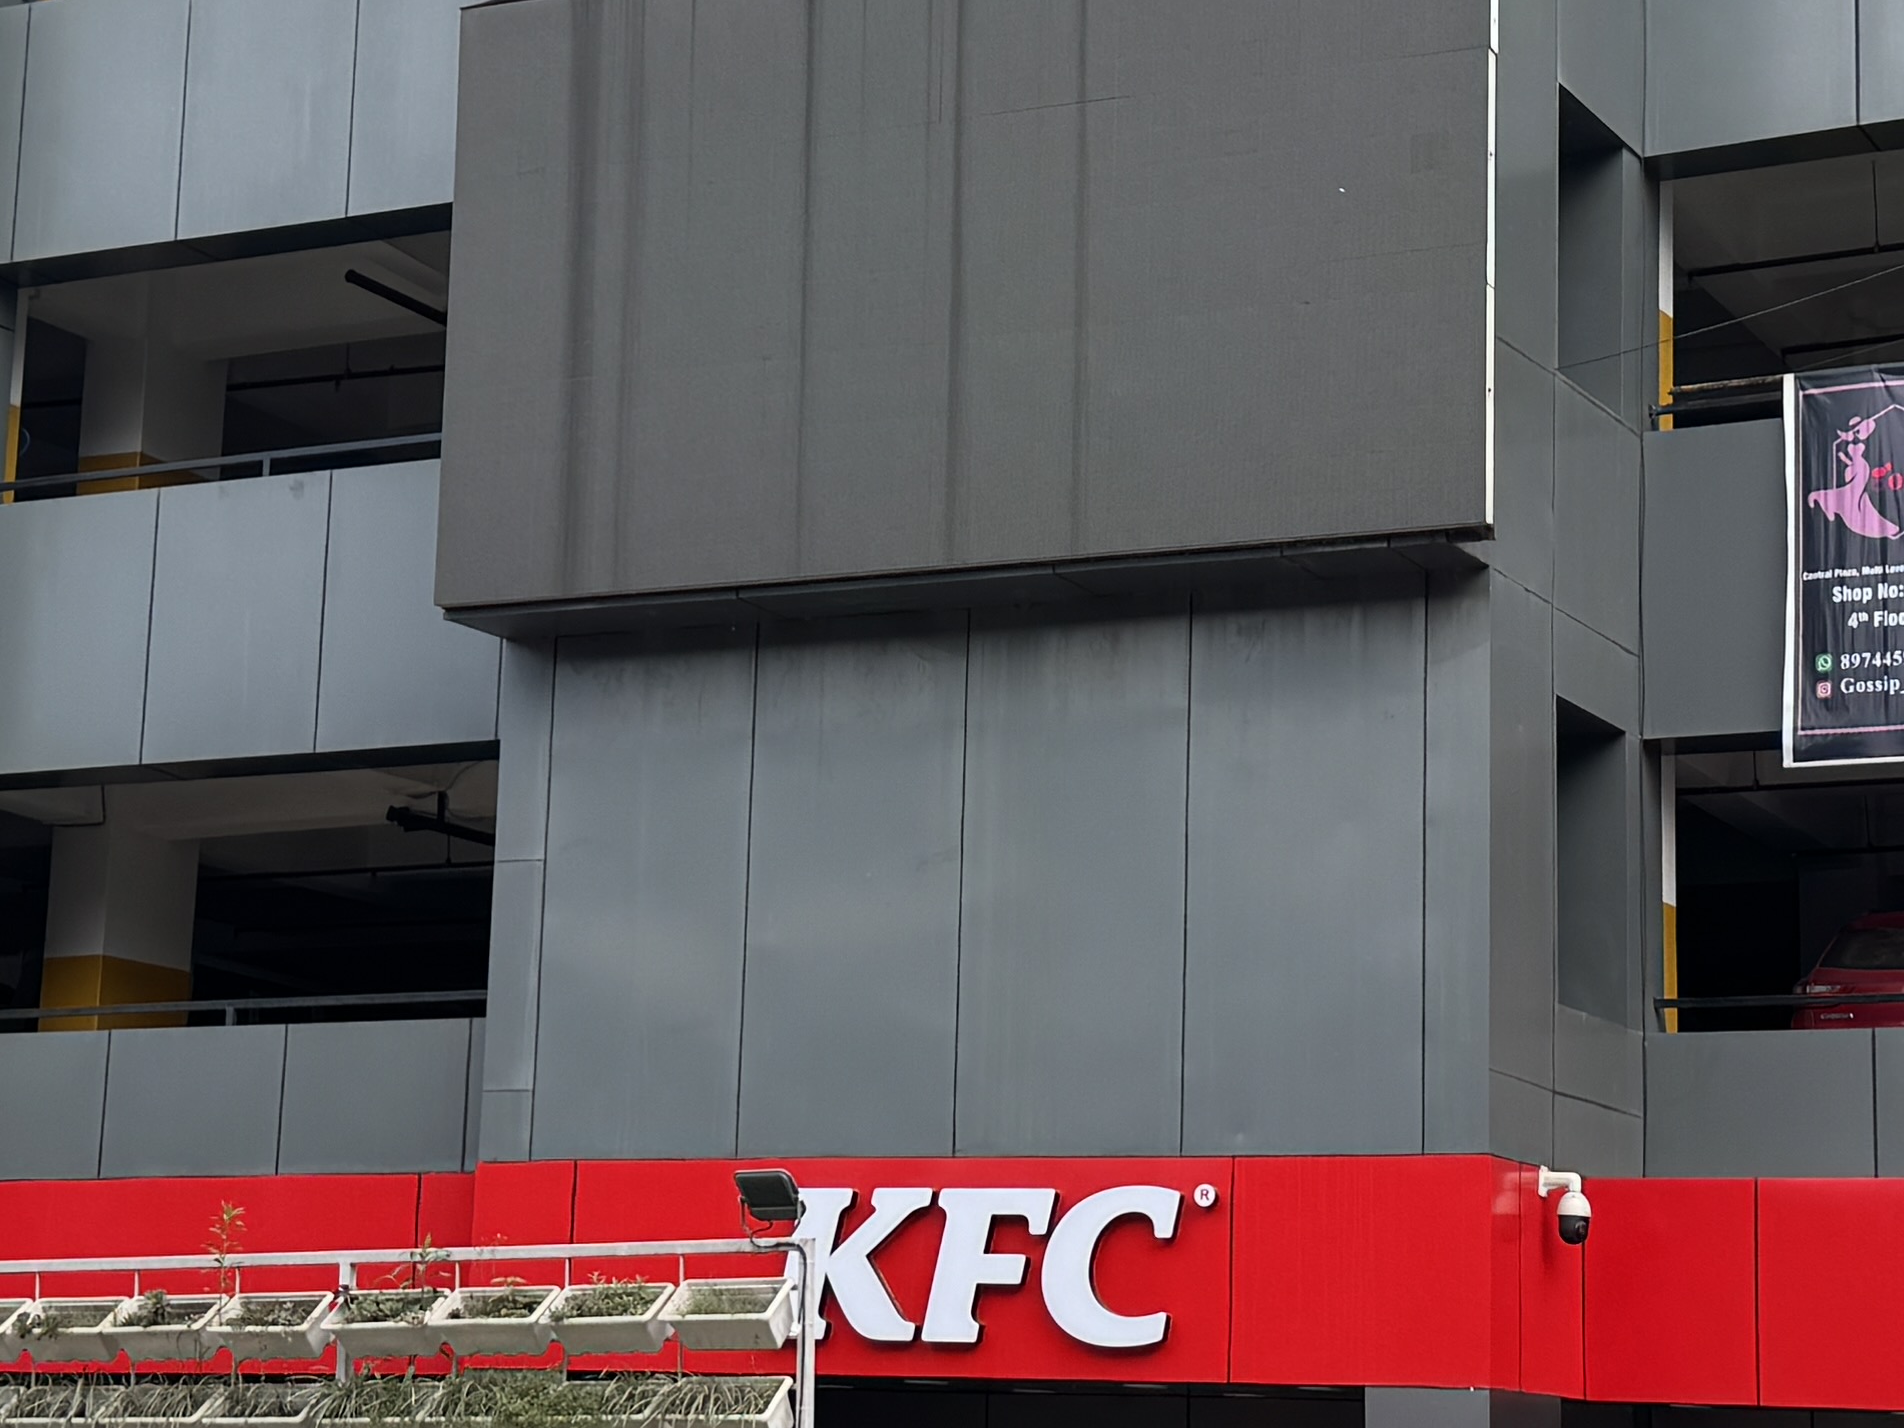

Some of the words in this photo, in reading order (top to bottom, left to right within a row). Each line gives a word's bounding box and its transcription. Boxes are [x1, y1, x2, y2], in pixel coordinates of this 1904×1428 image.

[1832, 584, 1872, 604] Shop
[1878, 582, 1904, 600] No:
[1848, 611, 1868, 628] 4th
[783, 1185, 1182, 1348] KFC
